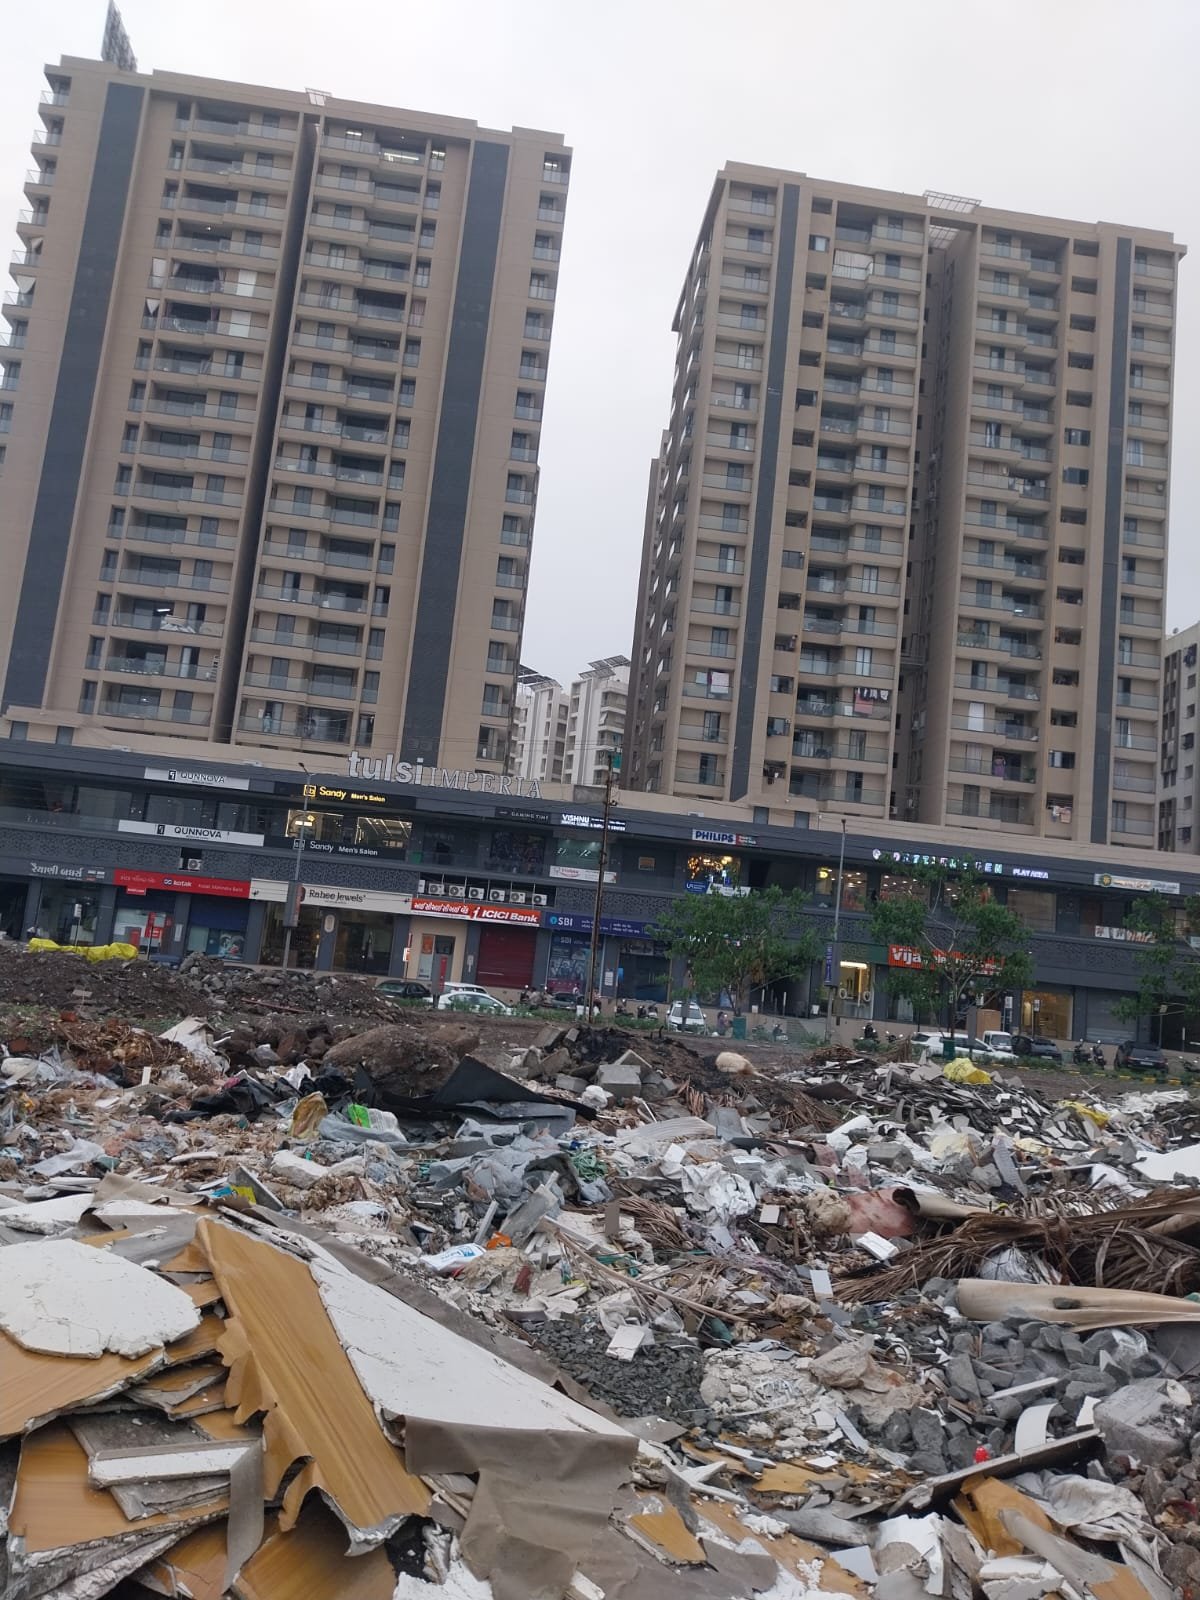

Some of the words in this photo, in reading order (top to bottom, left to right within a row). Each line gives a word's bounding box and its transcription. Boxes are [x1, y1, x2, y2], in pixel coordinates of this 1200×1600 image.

[180, 771, 225, 783] QUNNOVA
[348, 750, 424, 785] tulsi
[430, 766, 543, 799] IMPERIA
[320, 786, 347, 800] Sandy
[562, 813, 590, 823] VISHNU
[174, 826, 222, 838] QUNNOVA
[695, 830, 734, 842] PHILIPS
[310, 840, 334, 853] Sandy
[338, 846, 358, 854] Men's
[359, 848, 378, 856] Salon
[173, 879, 192, 887] kotak
[481, 909, 508, 920] ICICI
[509, 912, 538, 923] Bank
[557, 916, 574, 927] SBI
